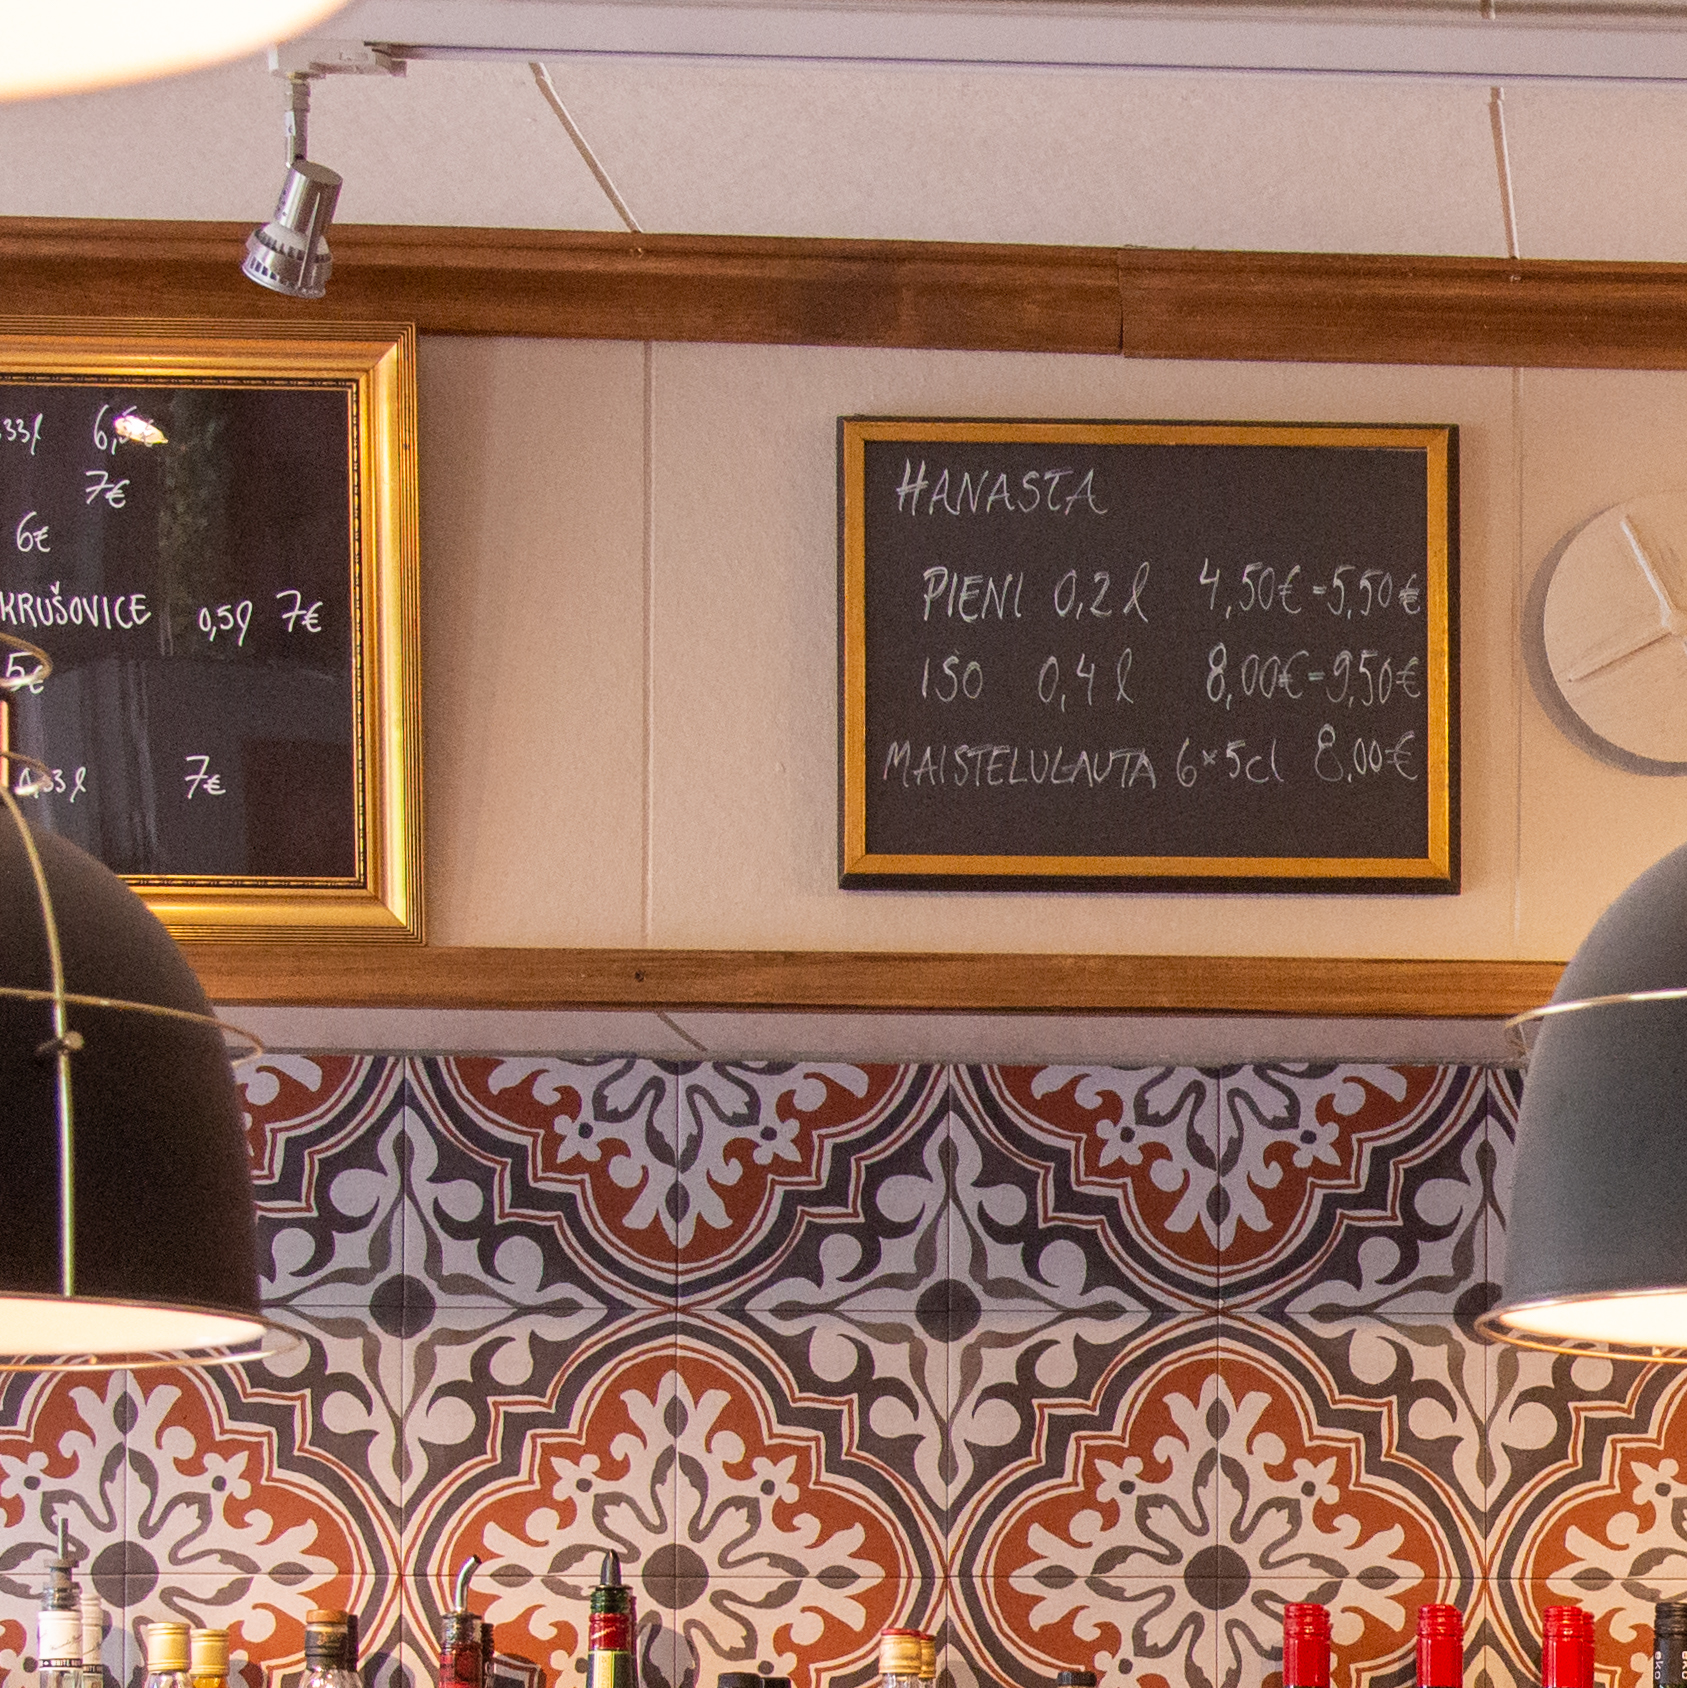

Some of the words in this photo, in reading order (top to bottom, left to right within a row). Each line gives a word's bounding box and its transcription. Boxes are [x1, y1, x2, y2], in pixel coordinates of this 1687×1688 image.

[85, 470, 131, 508] 7€
[896, 459, 1108, 516] HANASTA
[16, 511, 51, 552] 6€
[276, 589, 323, 633] 7€
[922, 564, 1023, 623] PIENI
[921, 646, 984, 700] ISO
[184, 755, 227, 799] 7€
[882, 738, 1157, 790] MAISTELULAUTA
